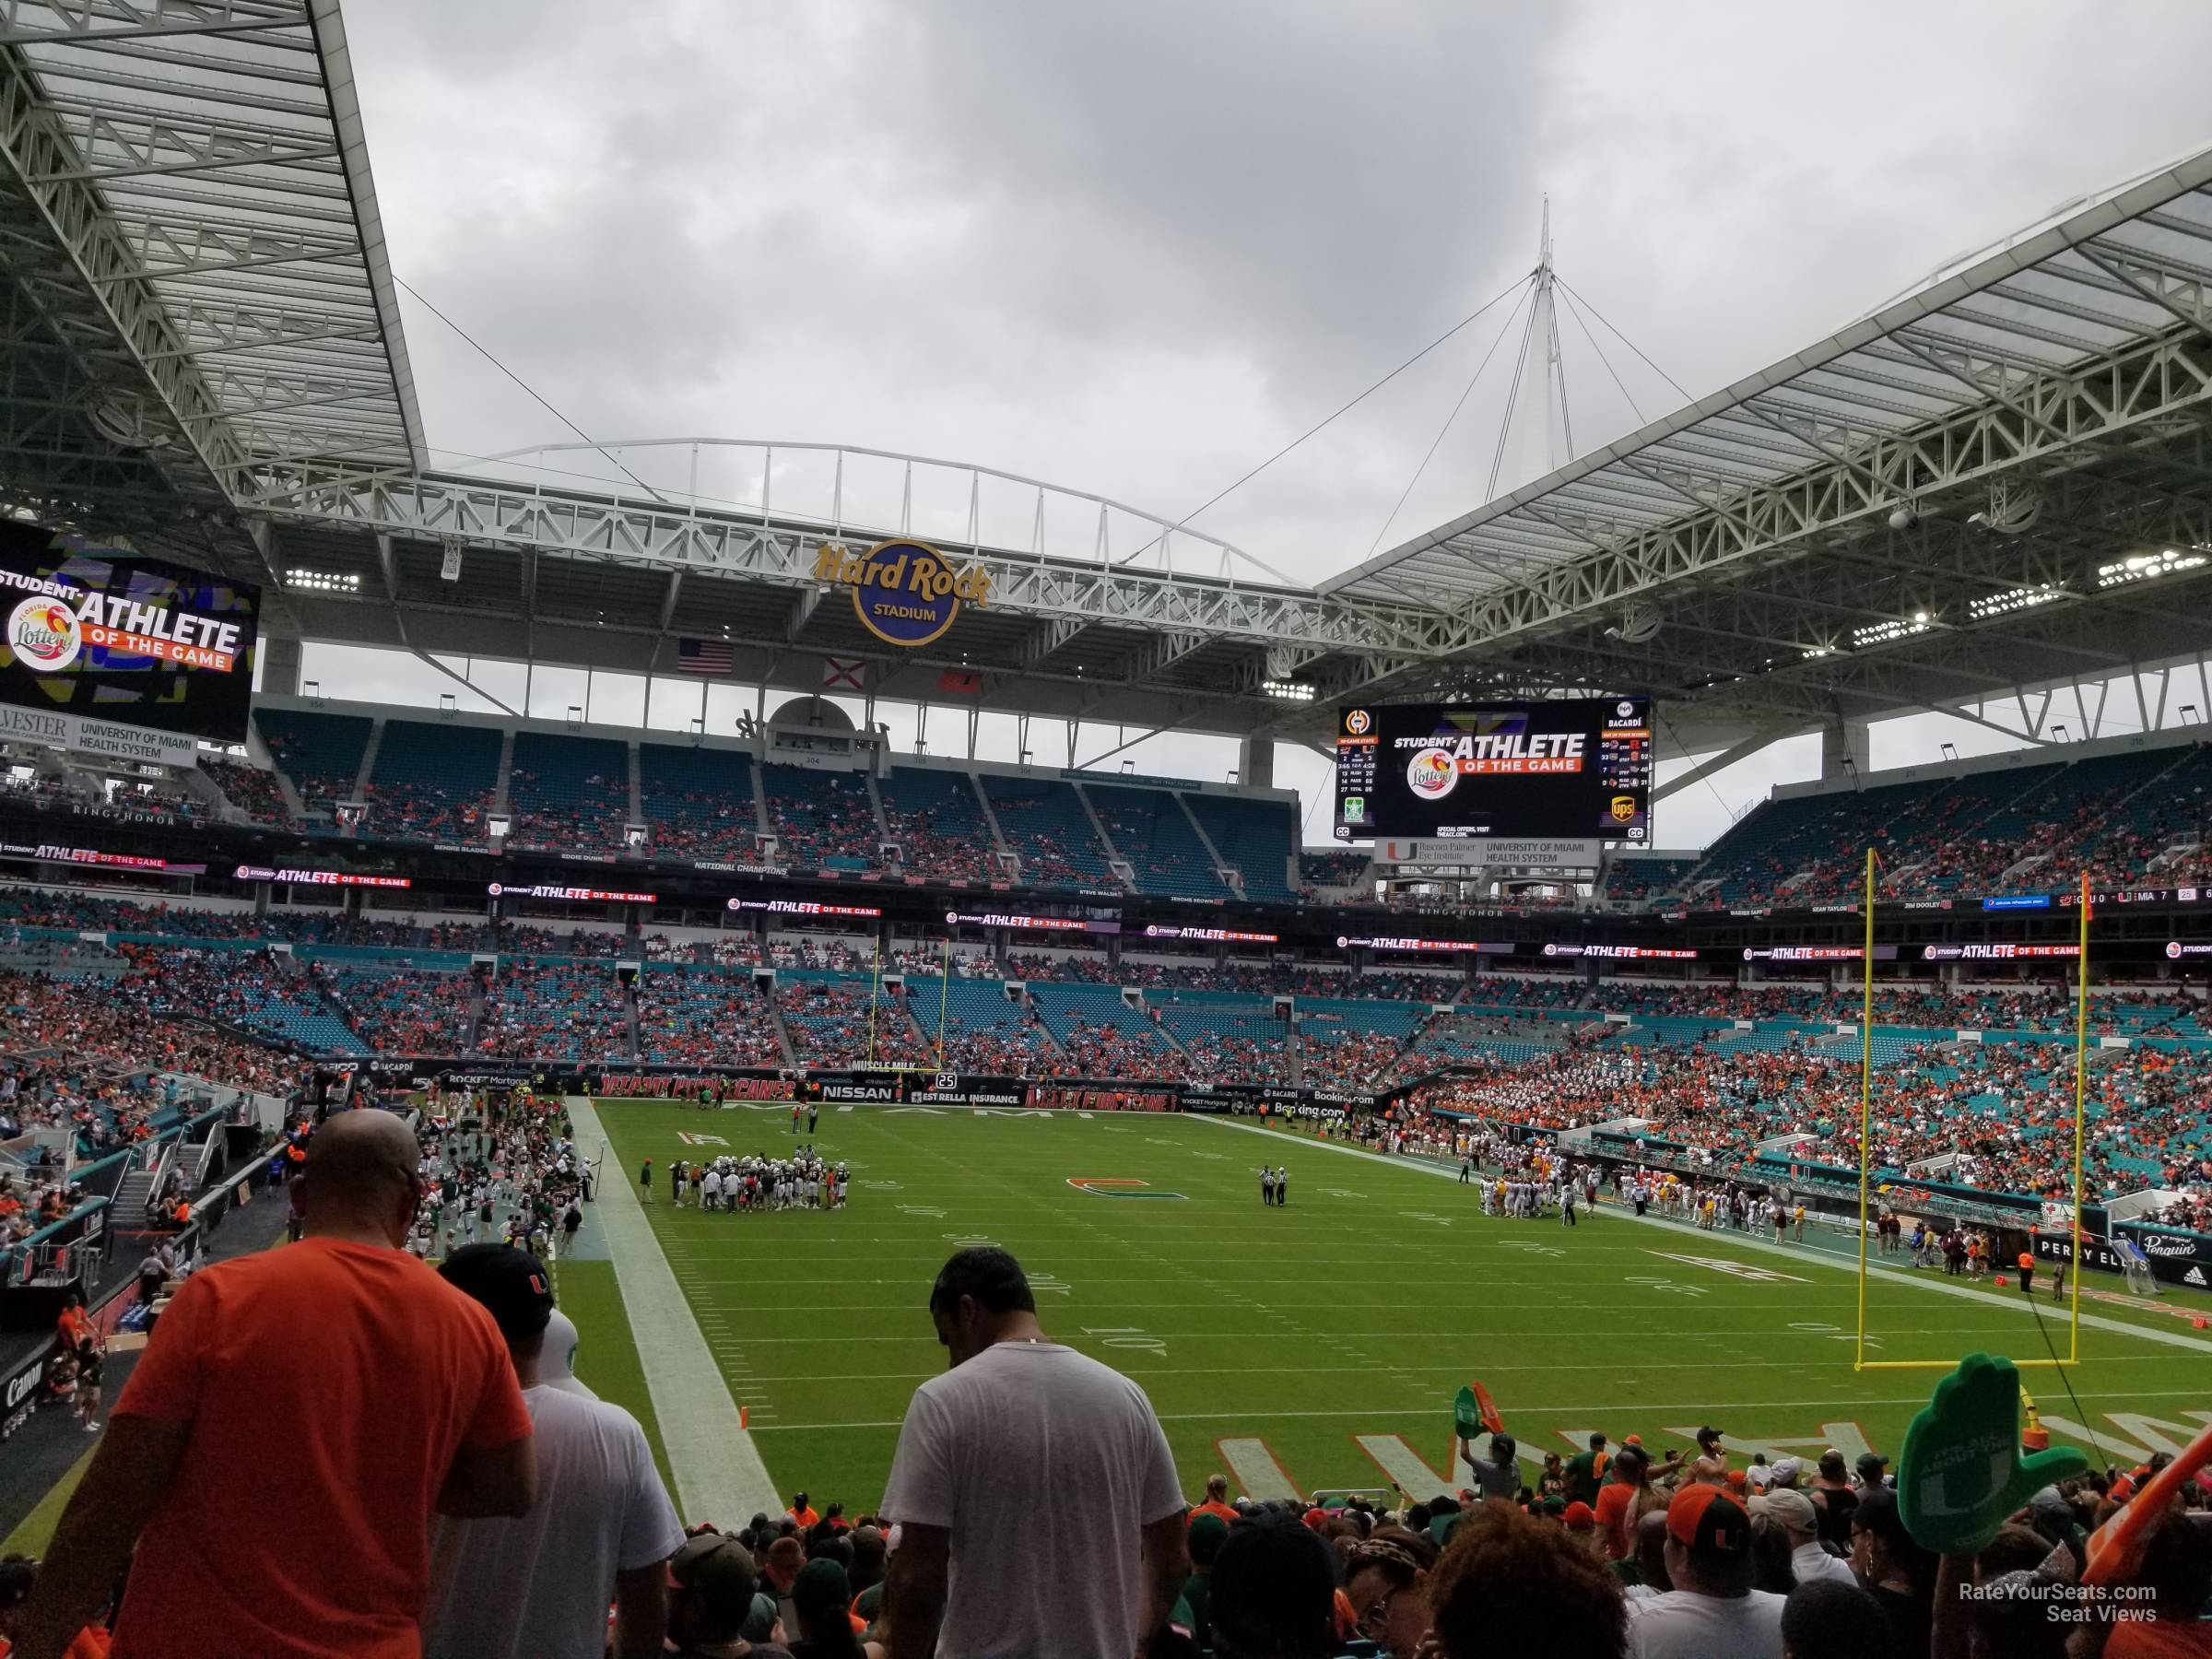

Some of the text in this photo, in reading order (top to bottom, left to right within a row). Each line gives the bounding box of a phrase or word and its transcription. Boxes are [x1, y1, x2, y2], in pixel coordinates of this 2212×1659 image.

[814, 545, 992, 607] Hard Rock
[874, 603, 936, 622] STADIUM
[76, 591, 241, 654] ATHLETE
[14, 621, 75, 654] Lottery
[91, 629, 225, 668] OF THE GAME
[81, 723, 192, 751] UNIVERSITY OF MIAMI
[79, 736, 161, 759] HEALTH SYSTEM
[1453, 733, 1586, 759] ATHLETE
[1465, 759, 1574, 771] OF THE GAME
[1412, 769, 1453, 788] Lottery
[74, 806, 110, 818] RING
[124, 812, 174, 826] HONOR
[1613, 805, 1633, 818] ups
[1630, 829, 1642, 837] CC
[1419, 842, 1476, 852] Bascom Palmer
[1487, 842, 1584, 853] UNIVERSITY OF MIAMI
[35, 845, 99, 863] ATHLETE
[117, 855, 134, 864] THE
[137, 858, 163, 867] GAME
[1418, 852, 1464, 861] Eye Institute
[1487, 853, 1557, 863] HEALTH SYSTEM
[695, 862, 788, 876] NATIONAL CHAMPIONS
[276, 869, 339, 884] ATHLETE
[342, 875, 354, 883] OF
[358, 877, 376, 885] THE
[532, 886, 591, 900] ATHLETE
[2138, 892, 2155, 900] MIA
[2161, 891, 2168, 900] 7
[767, 900, 820, 913] ATHLETE
[1460, 909, 1502, 917] HONOR
[982, 914, 1031, 926] ATHLETE
[1181, 927, 1226, 940] ATHLETE
[1371, 938, 1419, 948] ATHLETE
[1583, 946, 1639, 958] ATHLETE
[1772, 947, 1813, 959] ATHLETE
[1962, 945, 2016, 958] ATHLETE
[2018, 947, 2031, 955] OF
[2033, 947, 2051, 955] THE
[2053, 947, 2079, 955] GAME
[852, 1060, 917, 1073] MUSCLE MILK
[938, 1076, 954, 1087] 25
[823, 1086, 891, 1100] NISSAN
[1272, 1090, 1298, 1099] BACARDÍ
[2144, 1236, 2196, 1256] Penguin
[2100, 1253, 2147, 1271] ELLIS
[2184, 1276, 2207, 1285] adidas
[7, 1361, 43, 1407] Canon
[1920, 1448, 2012, 1516] U
